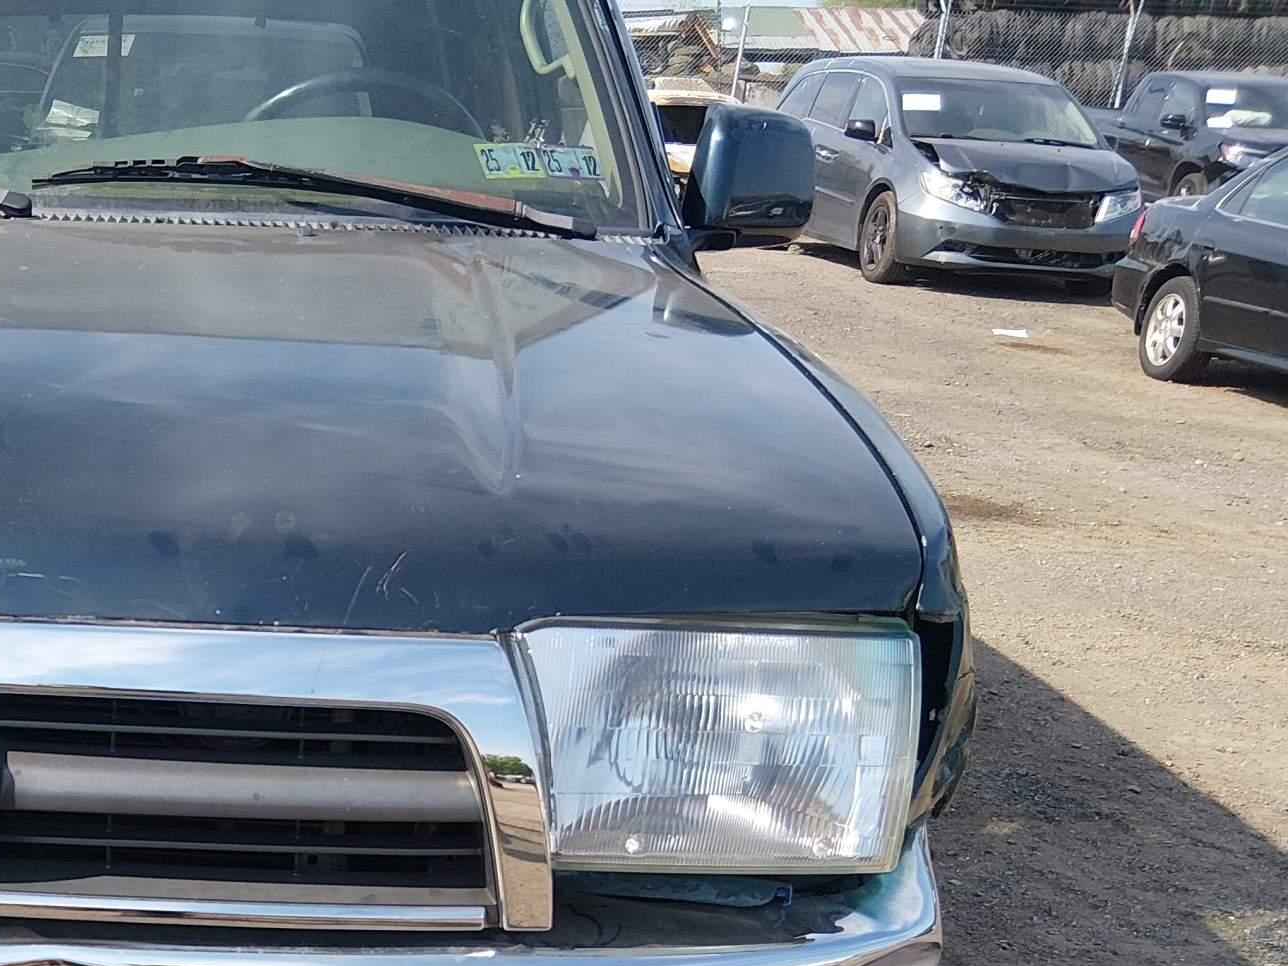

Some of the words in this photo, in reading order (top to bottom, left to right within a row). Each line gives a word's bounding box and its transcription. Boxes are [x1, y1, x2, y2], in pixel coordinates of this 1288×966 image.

[480, 149, 501, 172] 25
[520, 151, 540, 171] 12
[542, 150, 563, 173] 25
[582, 155, 601, 177] 12
